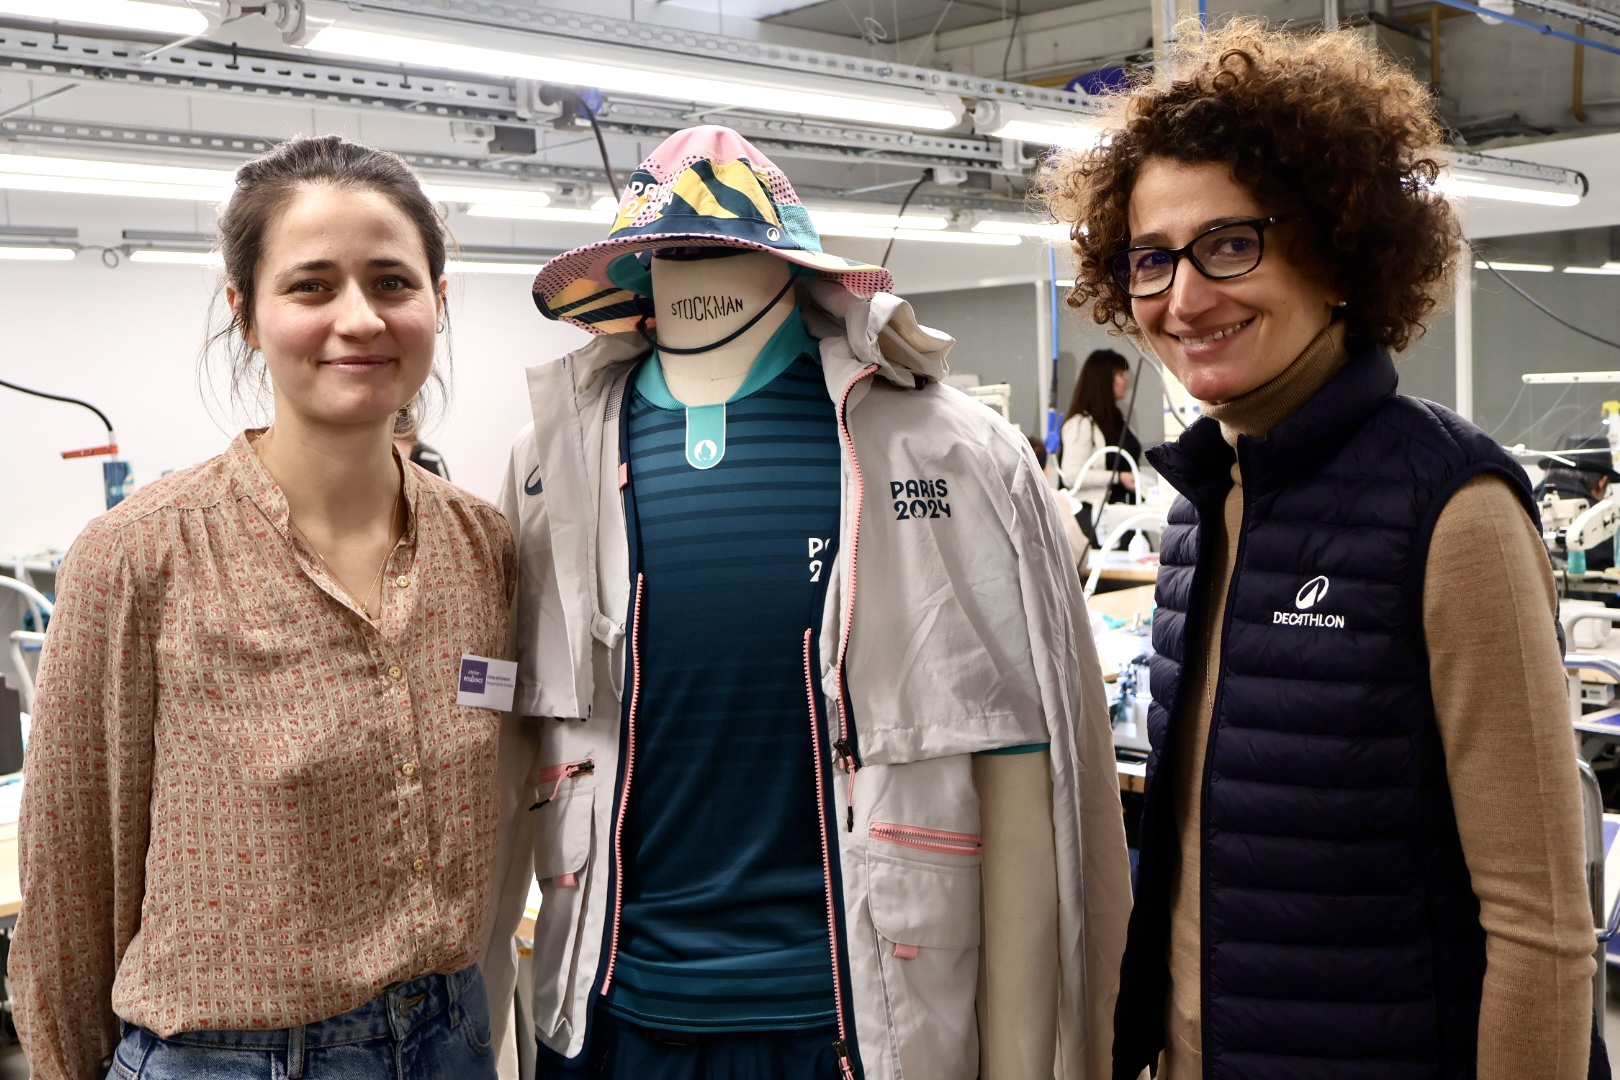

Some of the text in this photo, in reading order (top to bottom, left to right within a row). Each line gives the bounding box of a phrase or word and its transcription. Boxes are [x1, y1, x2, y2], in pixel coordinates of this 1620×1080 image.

[671, 296, 743, 321] STOCKMAN
[894, 499, 951, 520] 2024
[1272, 611, 1345, 628] DECATHLON
